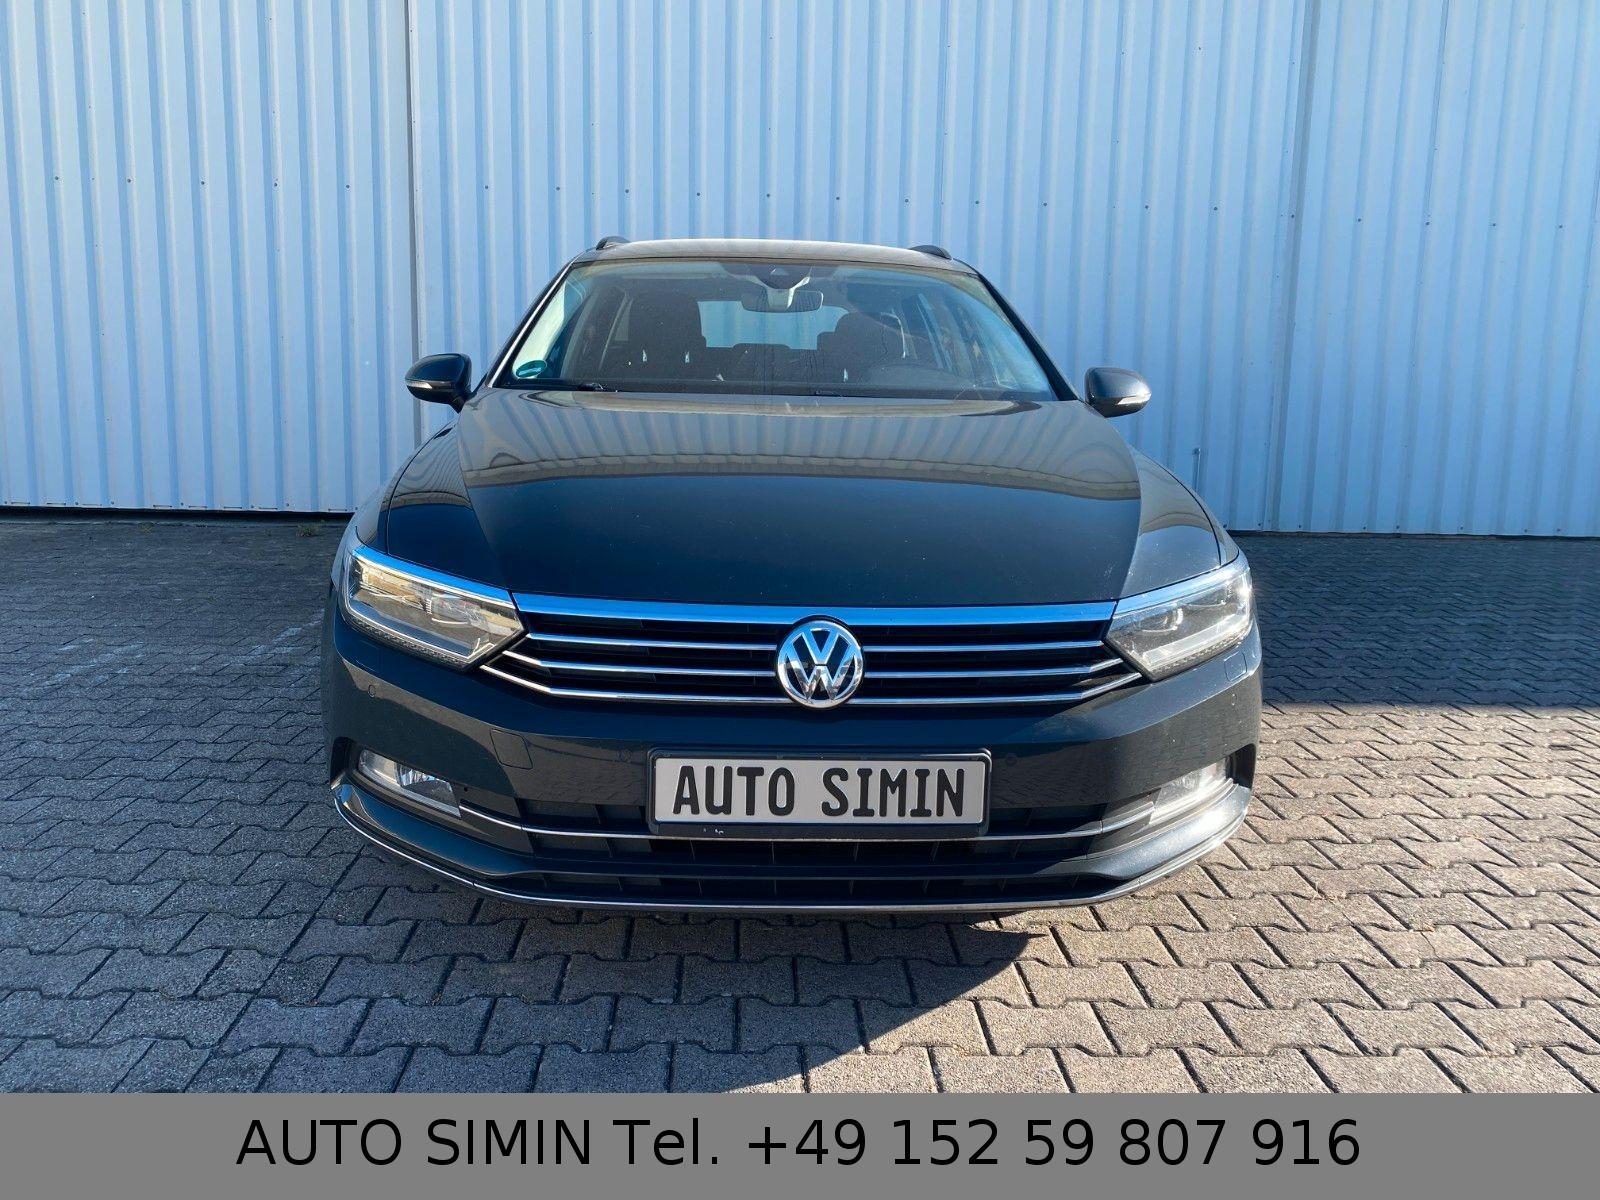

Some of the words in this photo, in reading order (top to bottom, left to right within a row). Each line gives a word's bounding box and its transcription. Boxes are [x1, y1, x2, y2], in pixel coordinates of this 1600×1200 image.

[781, 624, 860, 704] VW
[673, 765, 795, 816] AUTO
[821, 767, 965, 817] SIMIN
